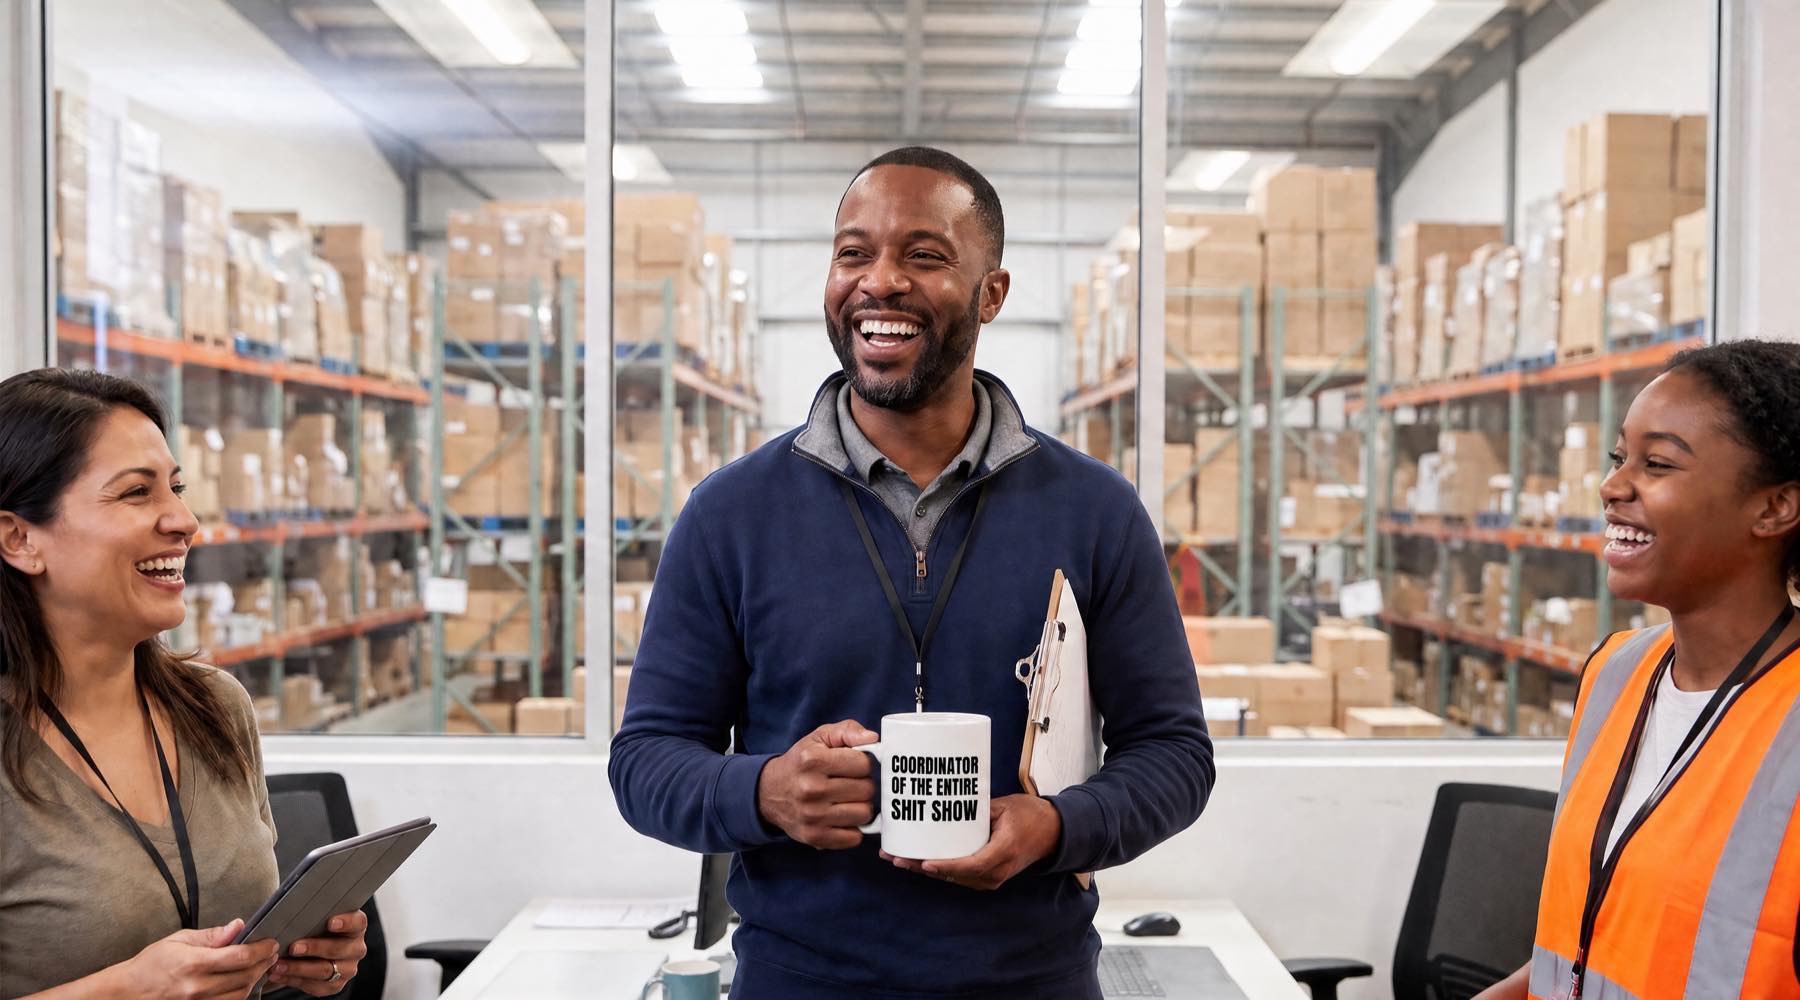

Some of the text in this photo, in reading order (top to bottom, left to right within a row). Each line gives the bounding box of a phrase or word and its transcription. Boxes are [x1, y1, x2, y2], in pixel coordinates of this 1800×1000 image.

[891, 755, 979, 774] COORDINATOR
[891, 777, 979, 796] OF THE ENTIRE
[891, 799, 979, 821] SHIT SHOW
